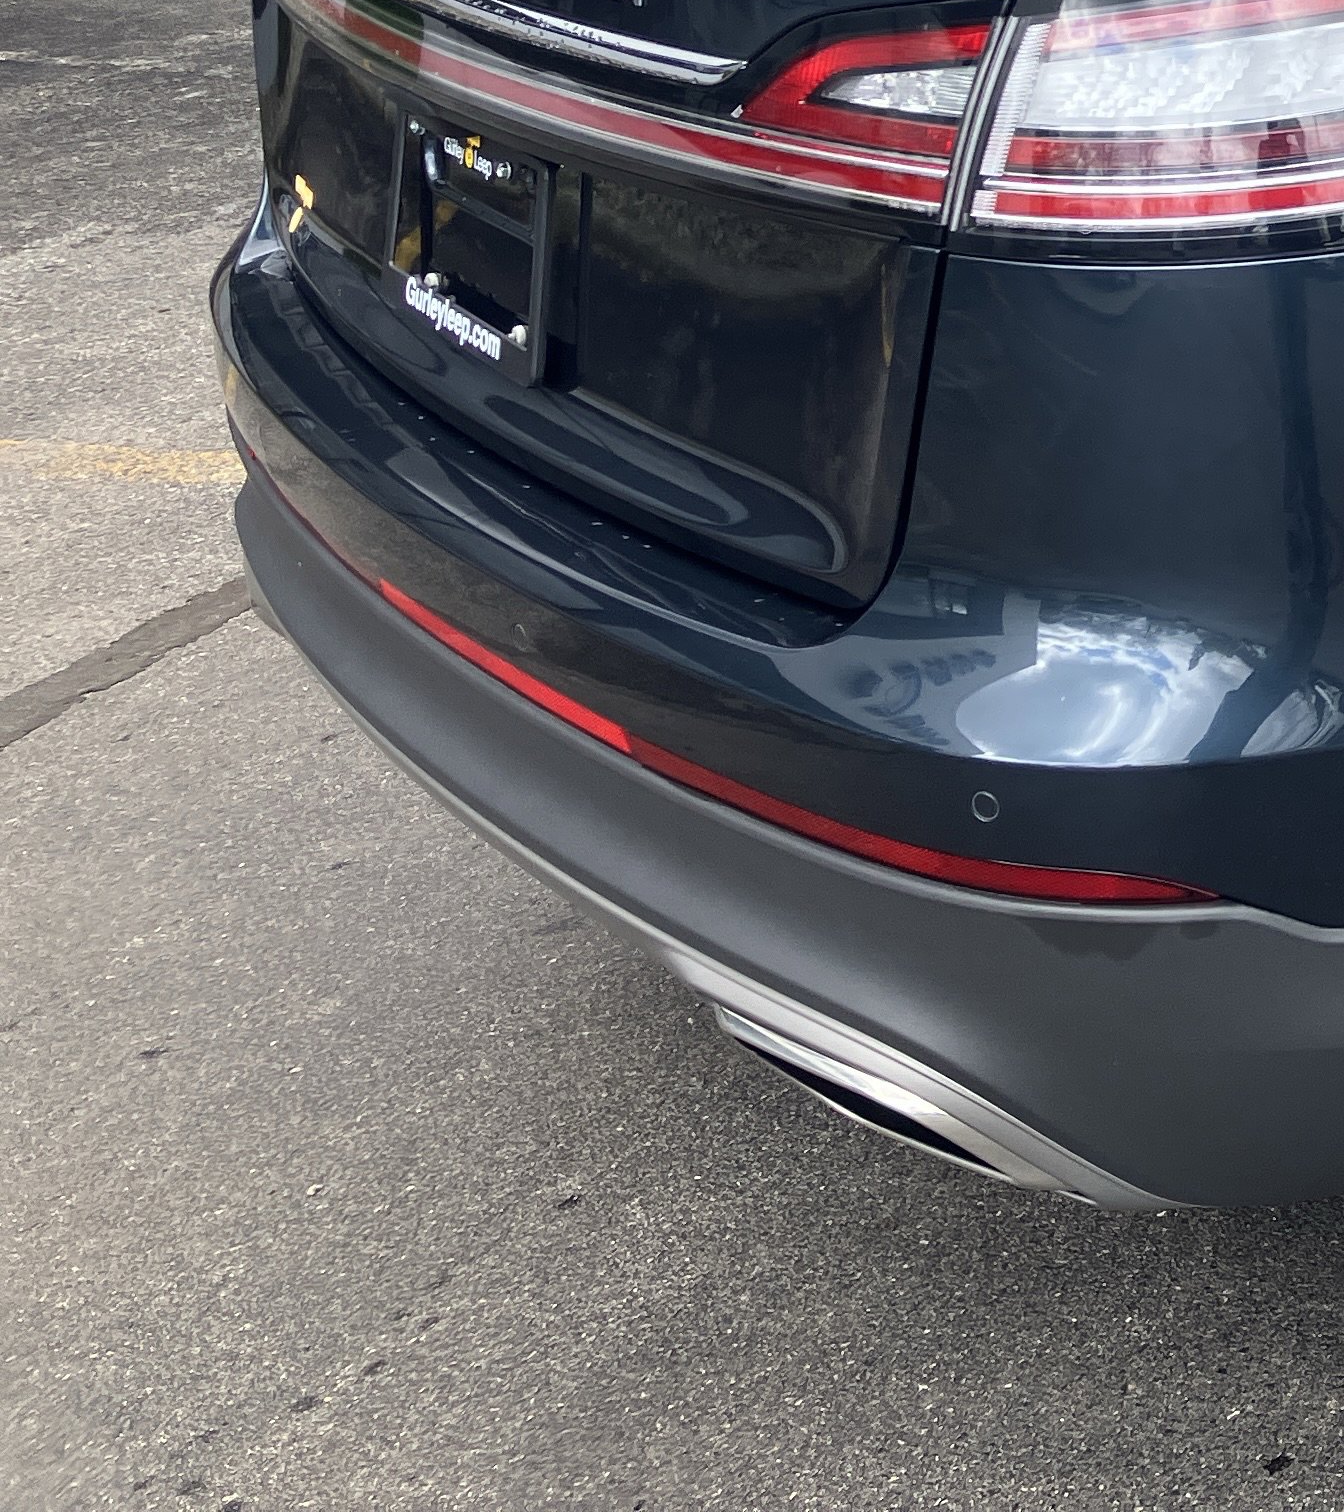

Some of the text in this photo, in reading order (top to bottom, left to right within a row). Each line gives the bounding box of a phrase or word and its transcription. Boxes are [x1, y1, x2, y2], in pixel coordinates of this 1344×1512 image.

[443, 136, 493, 181] Gurley Leep
[405, 276, 501, 361] Gurleyleep.com
